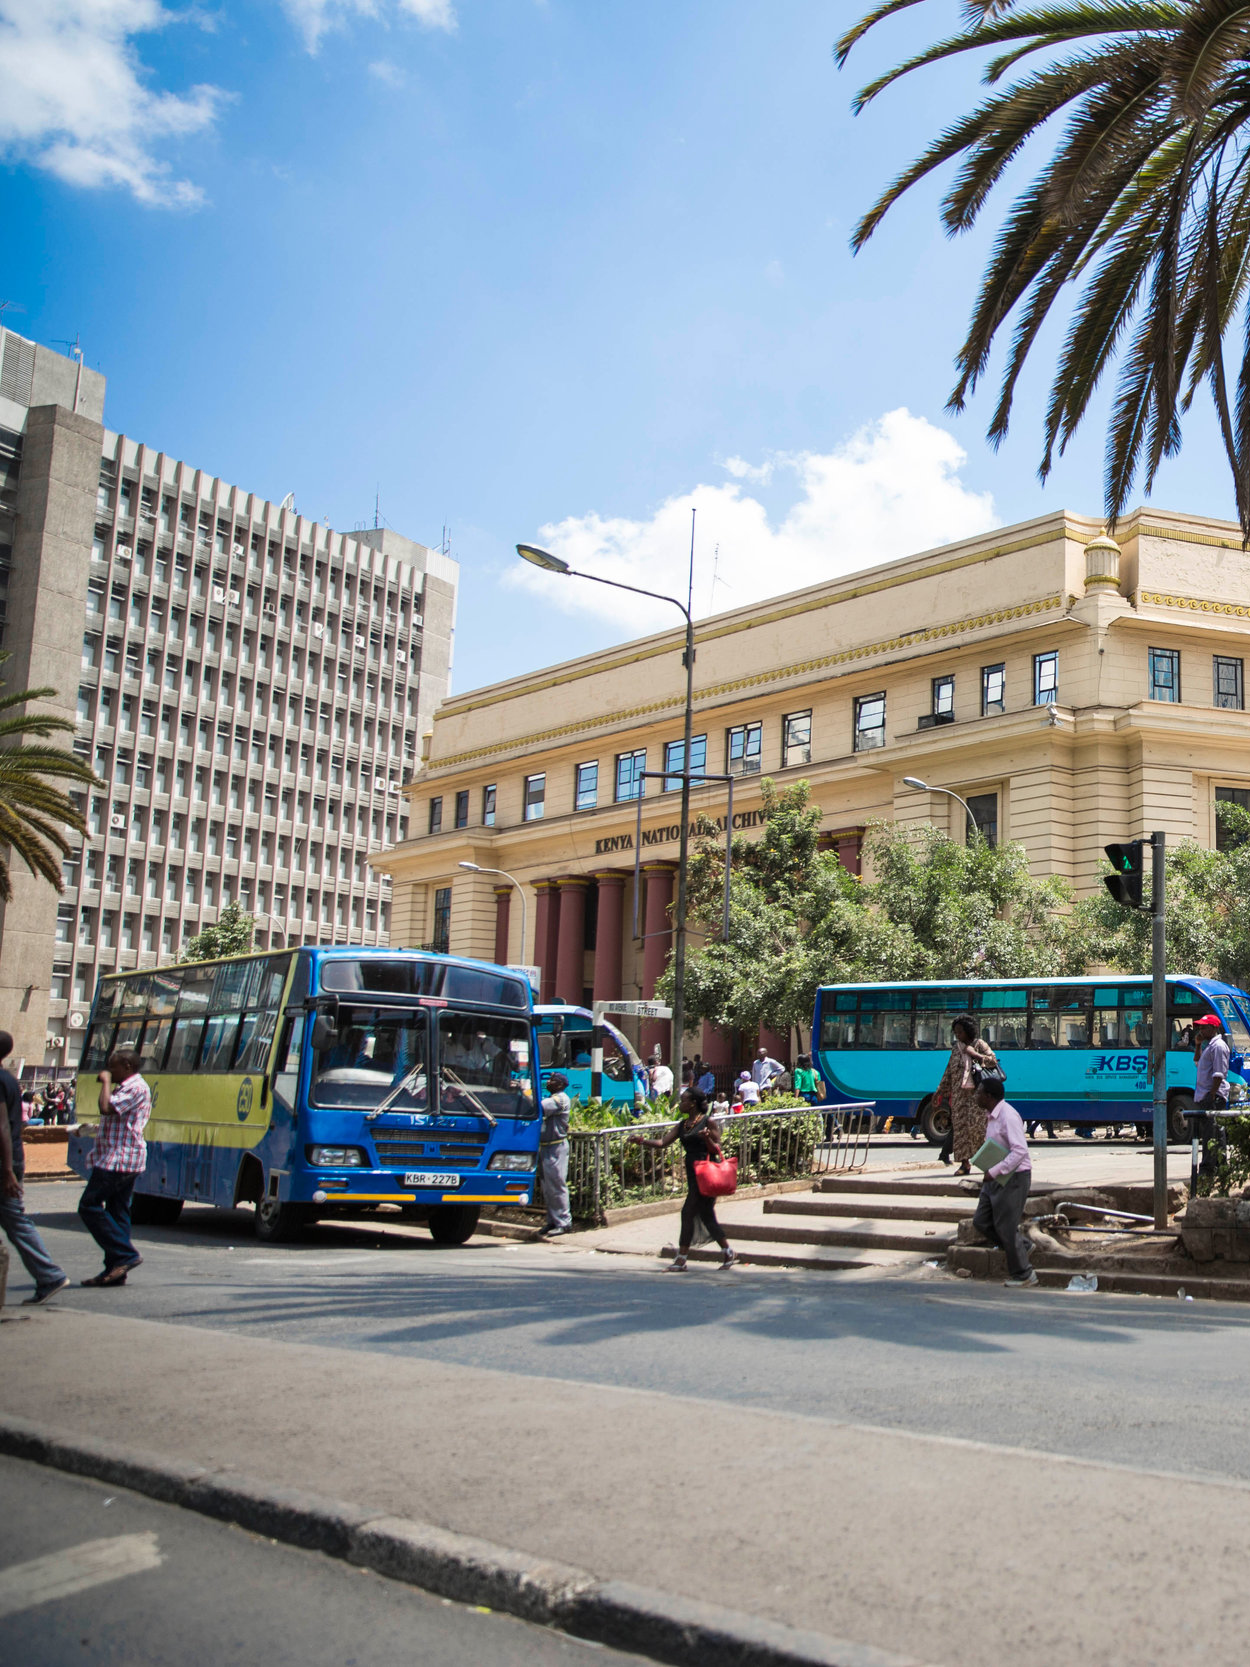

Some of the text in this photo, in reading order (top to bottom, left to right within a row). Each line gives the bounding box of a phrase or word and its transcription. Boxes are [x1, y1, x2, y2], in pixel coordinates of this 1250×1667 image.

[595, 834, 633, 854] KENYA
[641, 822, 706, 847] NATIOAL
[637, 1006, 658, 1016] STREET
[1098, 1056, 1148, 1071] KBS
[405, 1173, 458, 1185] KBR 227B
